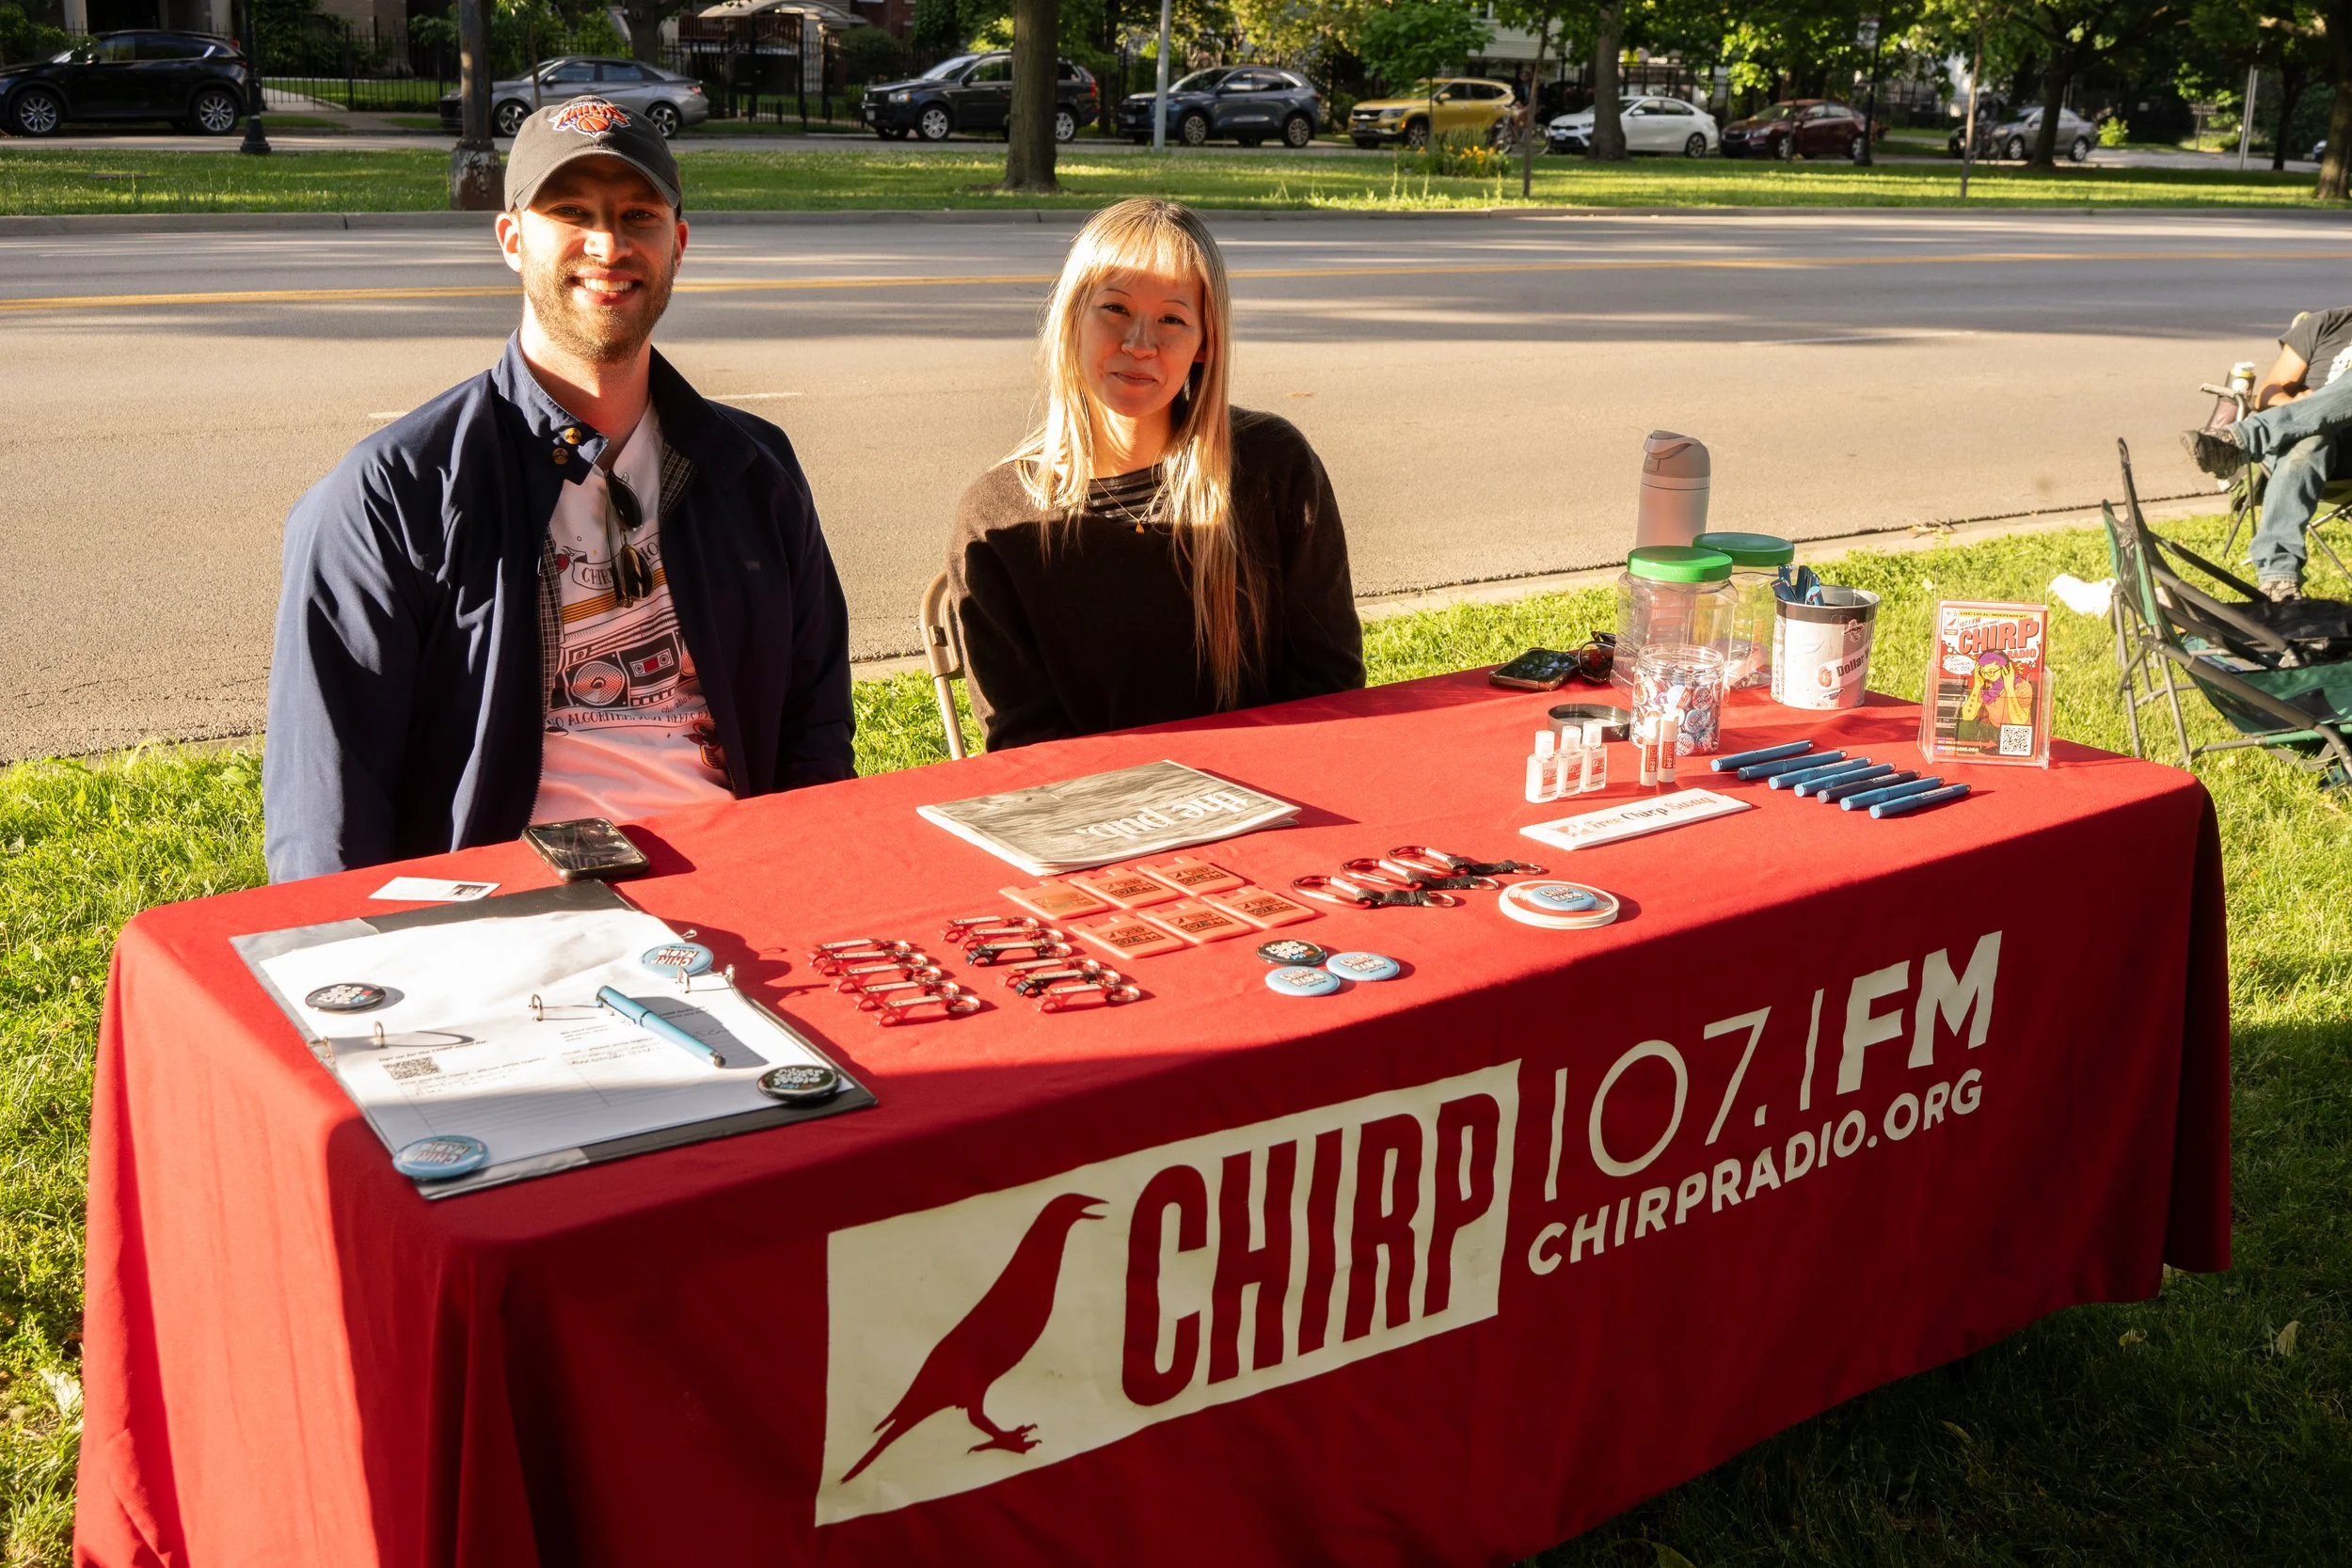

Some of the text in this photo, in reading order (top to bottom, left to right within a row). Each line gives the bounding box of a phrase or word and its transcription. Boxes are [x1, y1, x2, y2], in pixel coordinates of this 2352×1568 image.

[581, 566, 613, 585] CHIR
[1959, 619, 2040, 655] CHIRP
[1836, 655, 1865, 676] Dollar
[2008, 648, 2037, 659] RADIO
[1171, 791, 1249, 819] the
[1620, 806, 1669, 821] Chirp
[1545, 930, 2002, 1202] 107.1 FM
[1528, 1069, 1982, 1275] CHIRPRADIO.ORG
[1121, 1093, 1501, 1407] CHIRP
